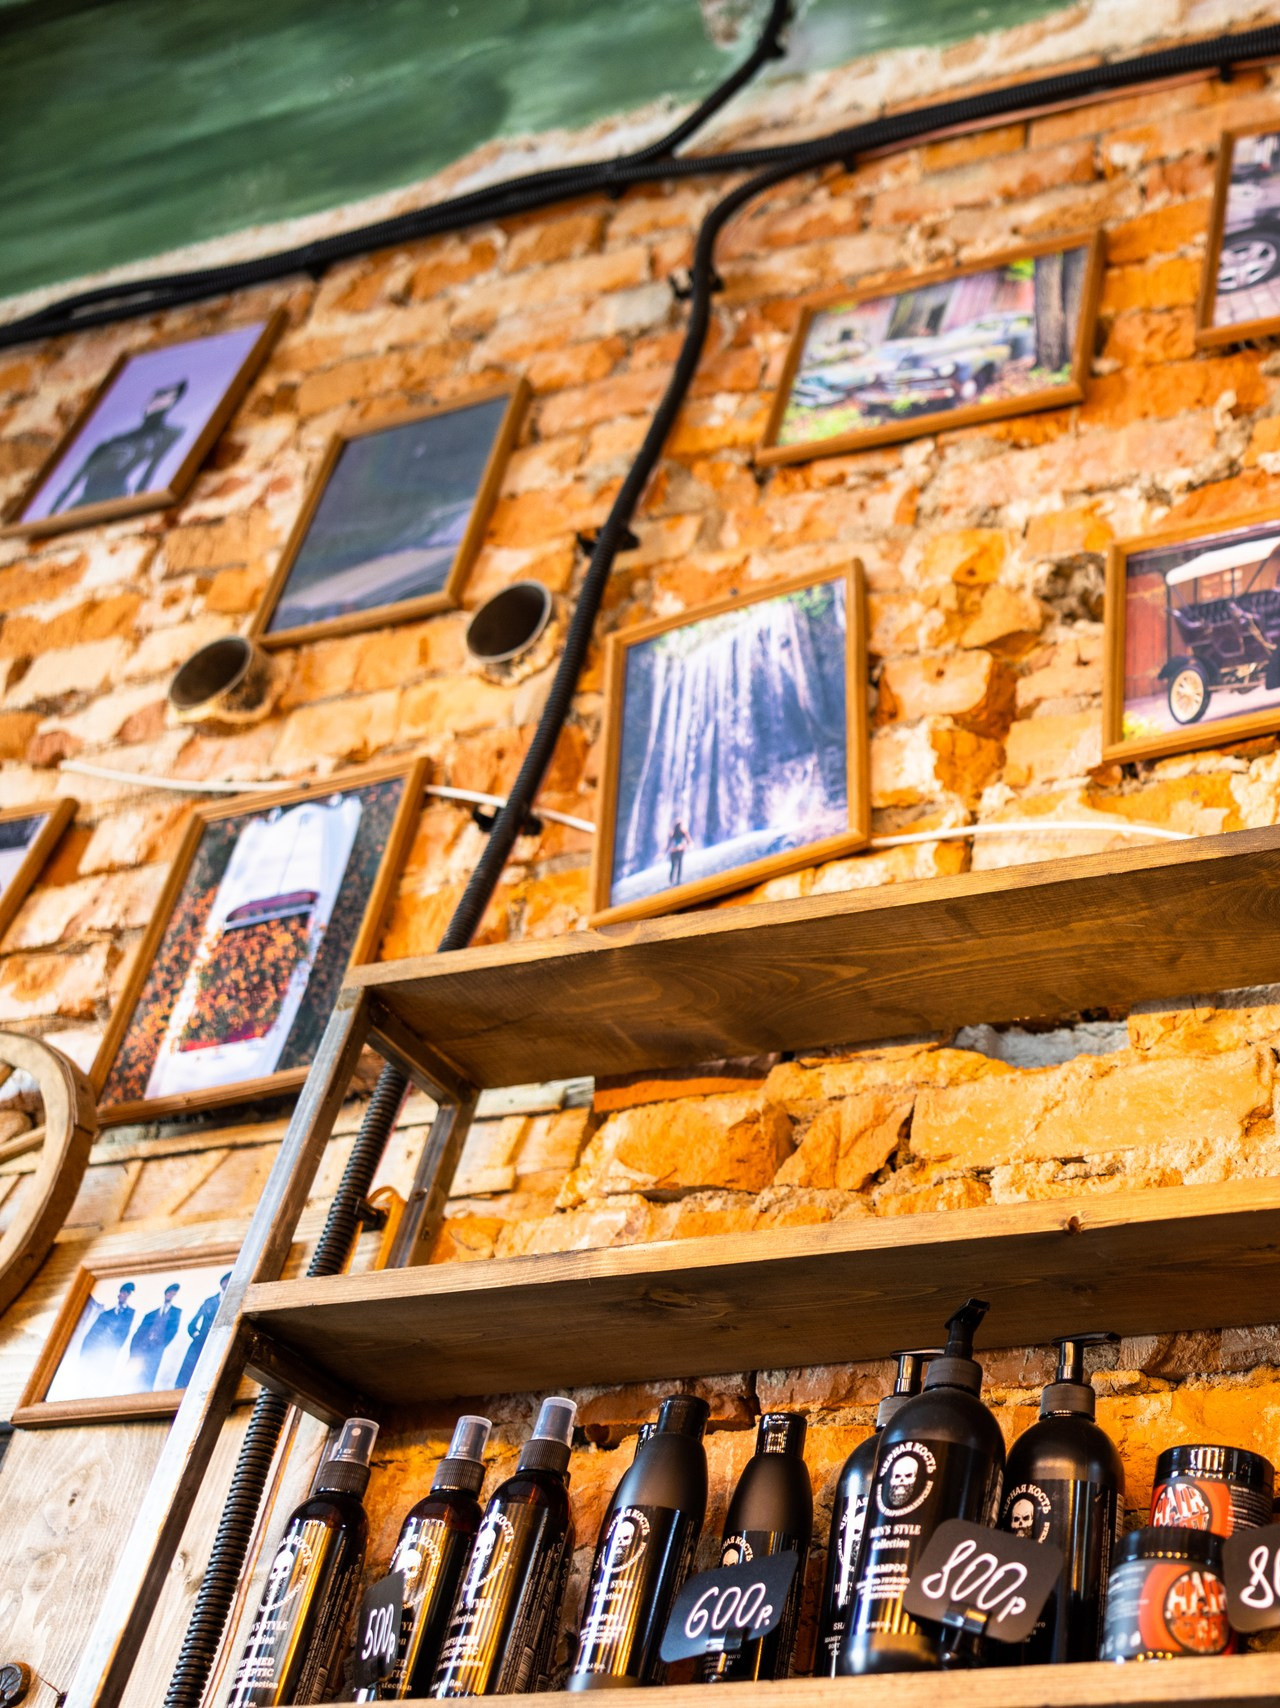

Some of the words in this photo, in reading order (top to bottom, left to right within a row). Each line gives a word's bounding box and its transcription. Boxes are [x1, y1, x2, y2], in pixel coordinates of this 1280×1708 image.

[913, 1442, 937, 1474] КОСТЬ
[1027, 1484, 1052, 1514] КОСТЬ
[893, 1524, 921, 1535] STYLE
[872, 1538, 910, 1550] Collection
